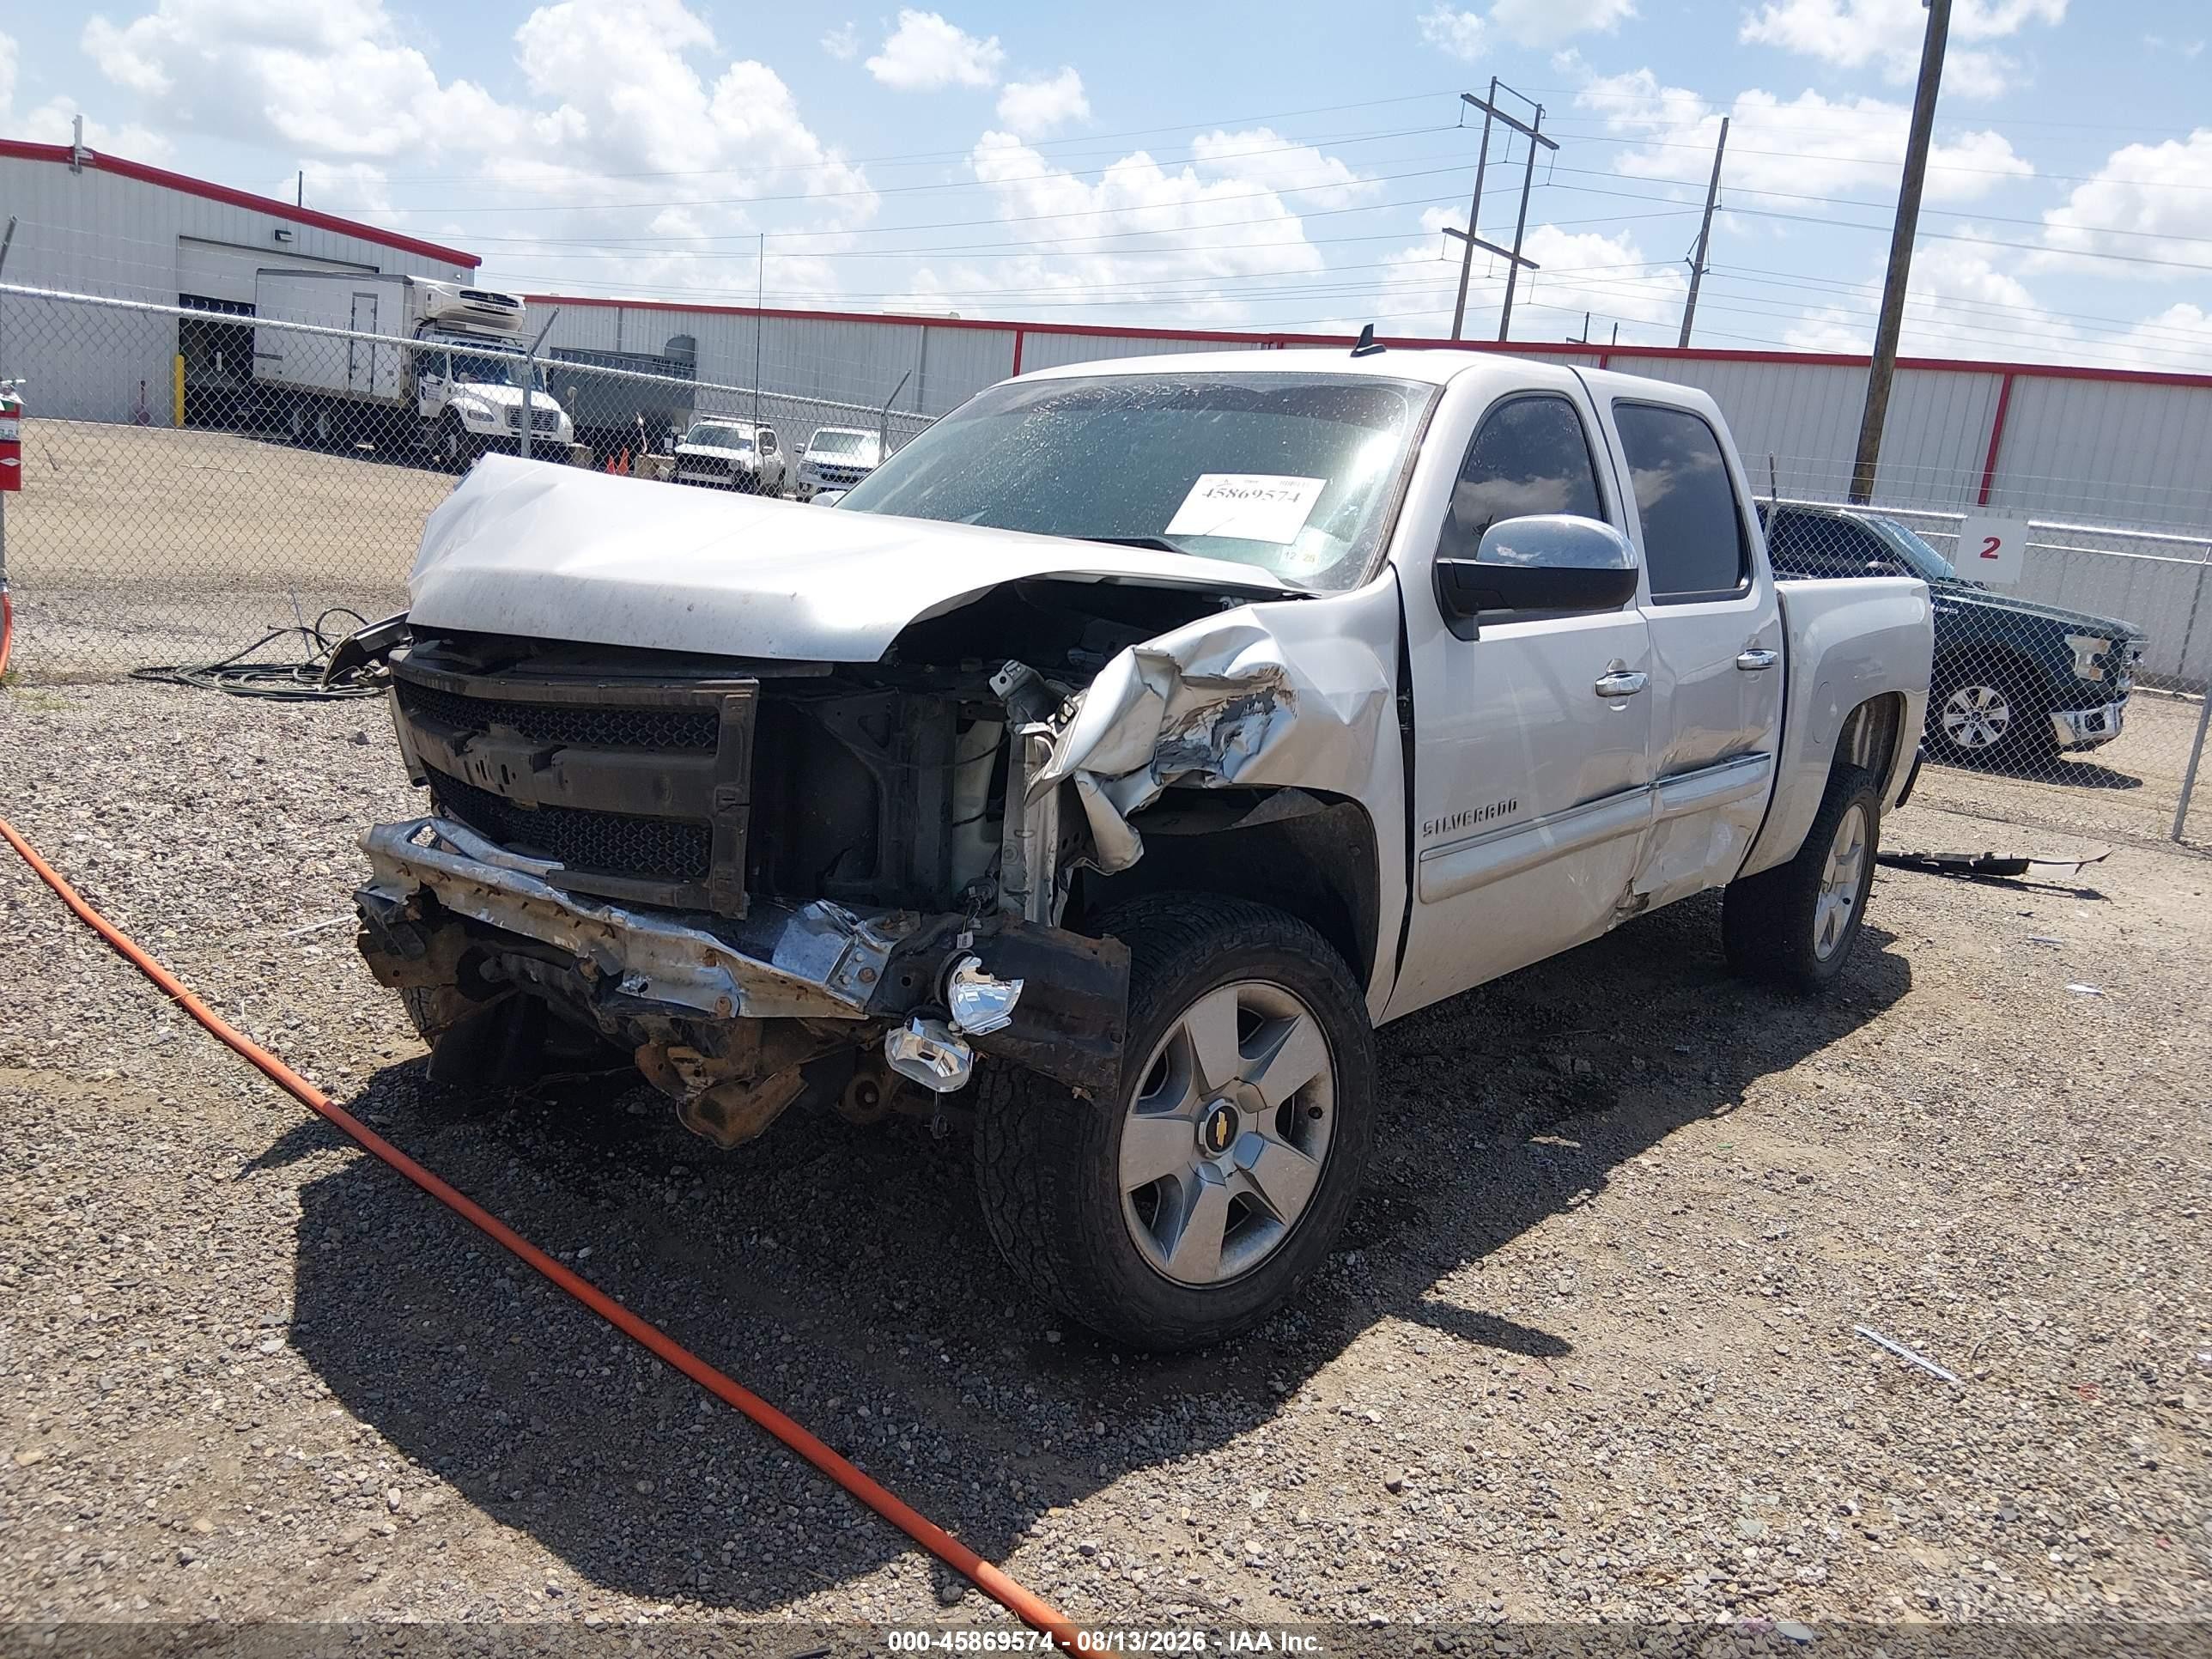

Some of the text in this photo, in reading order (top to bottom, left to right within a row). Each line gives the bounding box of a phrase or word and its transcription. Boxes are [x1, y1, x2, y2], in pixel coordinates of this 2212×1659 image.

[474, 301, 495, 310] THERMO
[1201, 487, 1301, 504] 45869574
[1979, 537, 2001, 560] 2
[1422, 797, 1518, 838] SILVERADO
